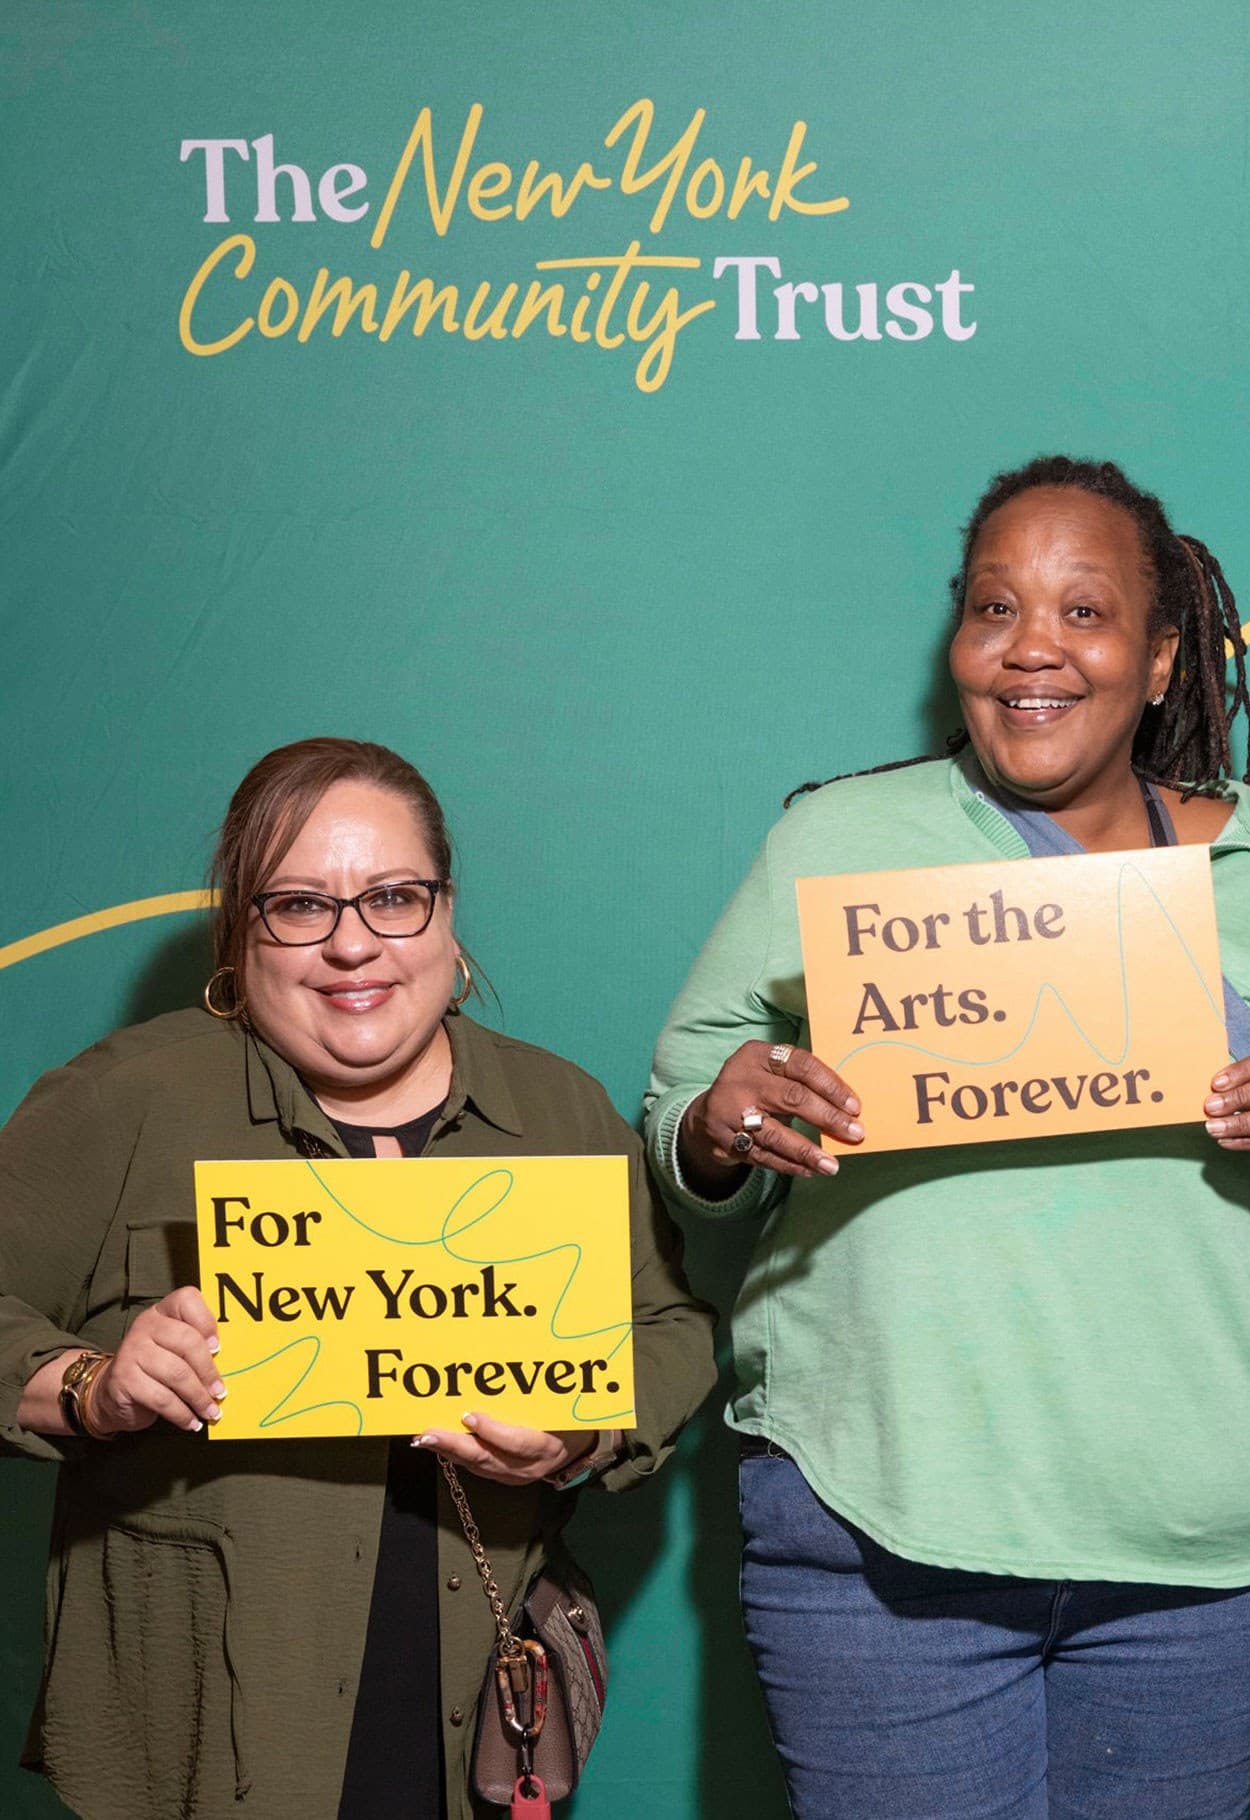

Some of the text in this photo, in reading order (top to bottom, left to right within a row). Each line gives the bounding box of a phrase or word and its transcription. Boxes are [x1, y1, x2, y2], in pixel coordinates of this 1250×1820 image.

[180, 98, 850, 249] The New York
[179, 233, 977, 393] Community Trust
[842, 889, 1066, 957] For the
[852, 982, 1007, 1035] Arts.
[912, 1067, 1165, 1125] Forever.
[211, 1196, 322, 1248] For
[214, 1264, 537, 1323] New York.
[364, 1348, 620, 1399] Forever.
